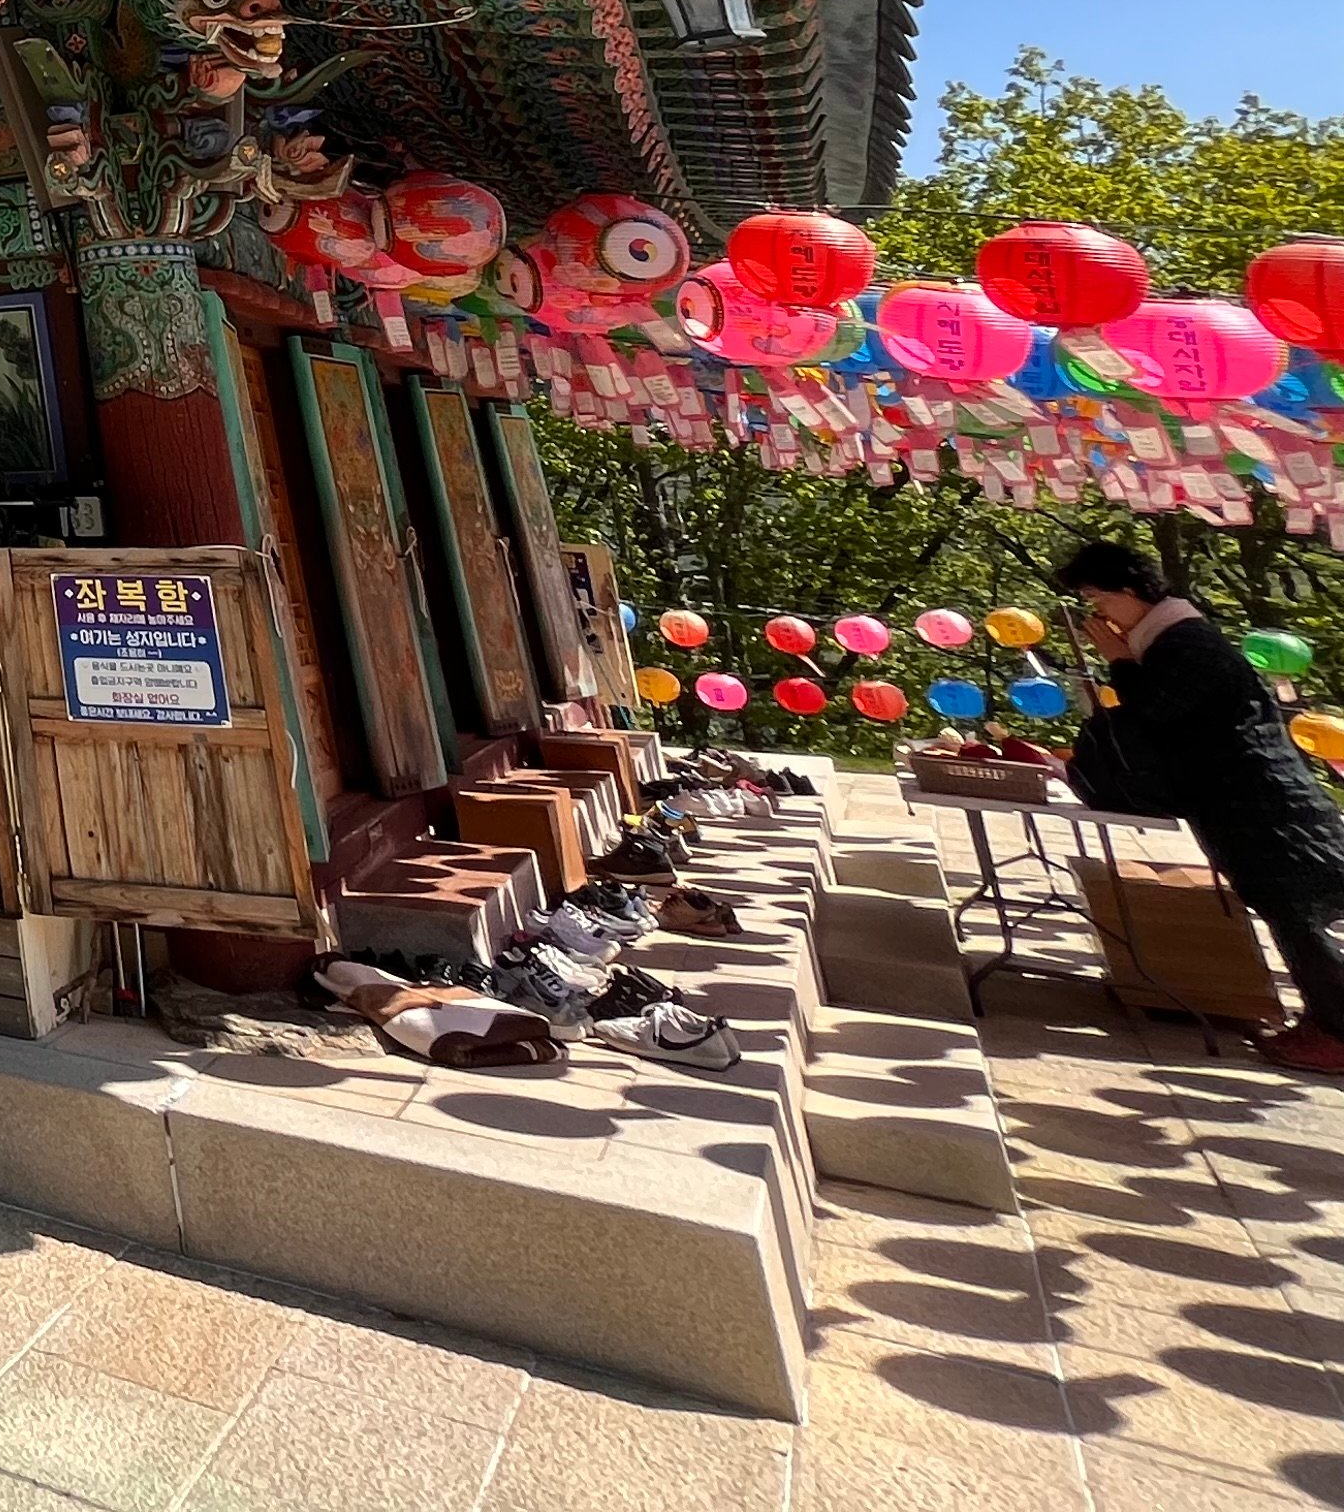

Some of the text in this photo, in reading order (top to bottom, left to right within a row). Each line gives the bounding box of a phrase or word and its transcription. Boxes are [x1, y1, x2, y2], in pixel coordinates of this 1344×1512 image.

[79, 629, 197, 648] 여기는 성지입니다
[112, 691, 181, 705] 화장실 없어요
